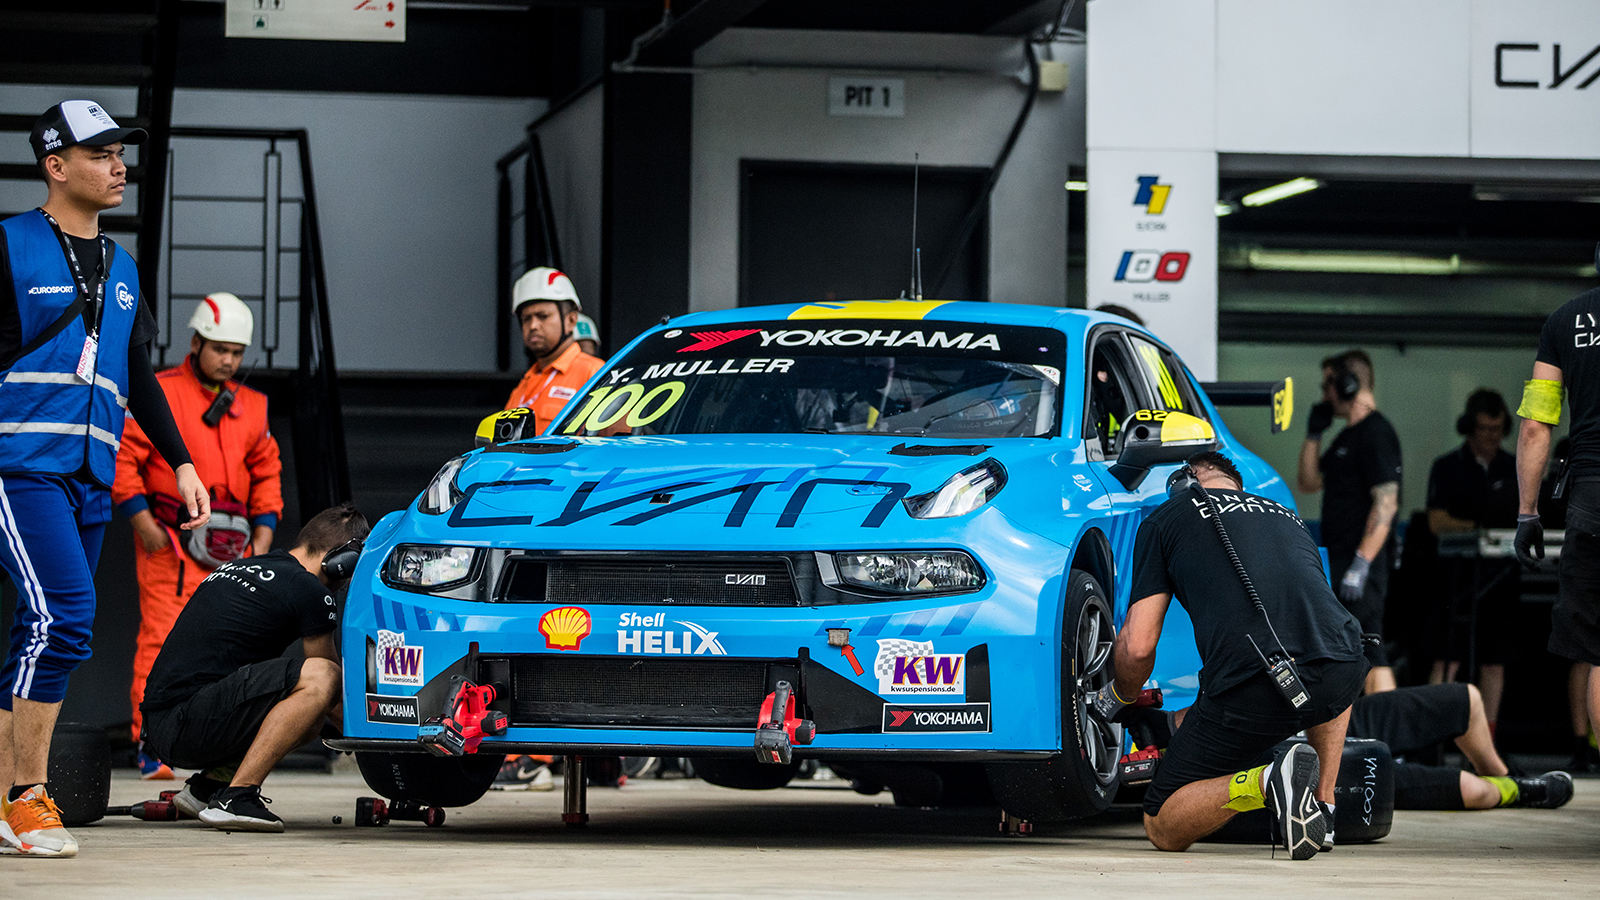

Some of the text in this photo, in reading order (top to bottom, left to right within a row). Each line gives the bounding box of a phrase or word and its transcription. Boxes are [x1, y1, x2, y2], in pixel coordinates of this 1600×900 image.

[845, 86, 890, 107] PIT 1
[1114, 252, 1190, 281] 100
[30, 286, 74, 294] EUROSPORT
[759, 330, 1001, 351] YOKOHAMA
[609, 358, 795, 385] Y. MULLER
[563, 381, 686, 434] 100
[1136, 409, 1168, 421] 62
[725, 574, 766, 585] CYAN
[619, 612, 666, 627] Shell
[616, 627, 727, 655] HELIX
[385, 647, 422, 677] KW
[892, 656, 963, 685] KW
[890, 685, 956, 693] kwsuspensions.de
[378, 703, 416, 718] YOKOHAMA
[913, 711, 984, 725] YOKOHAMA
